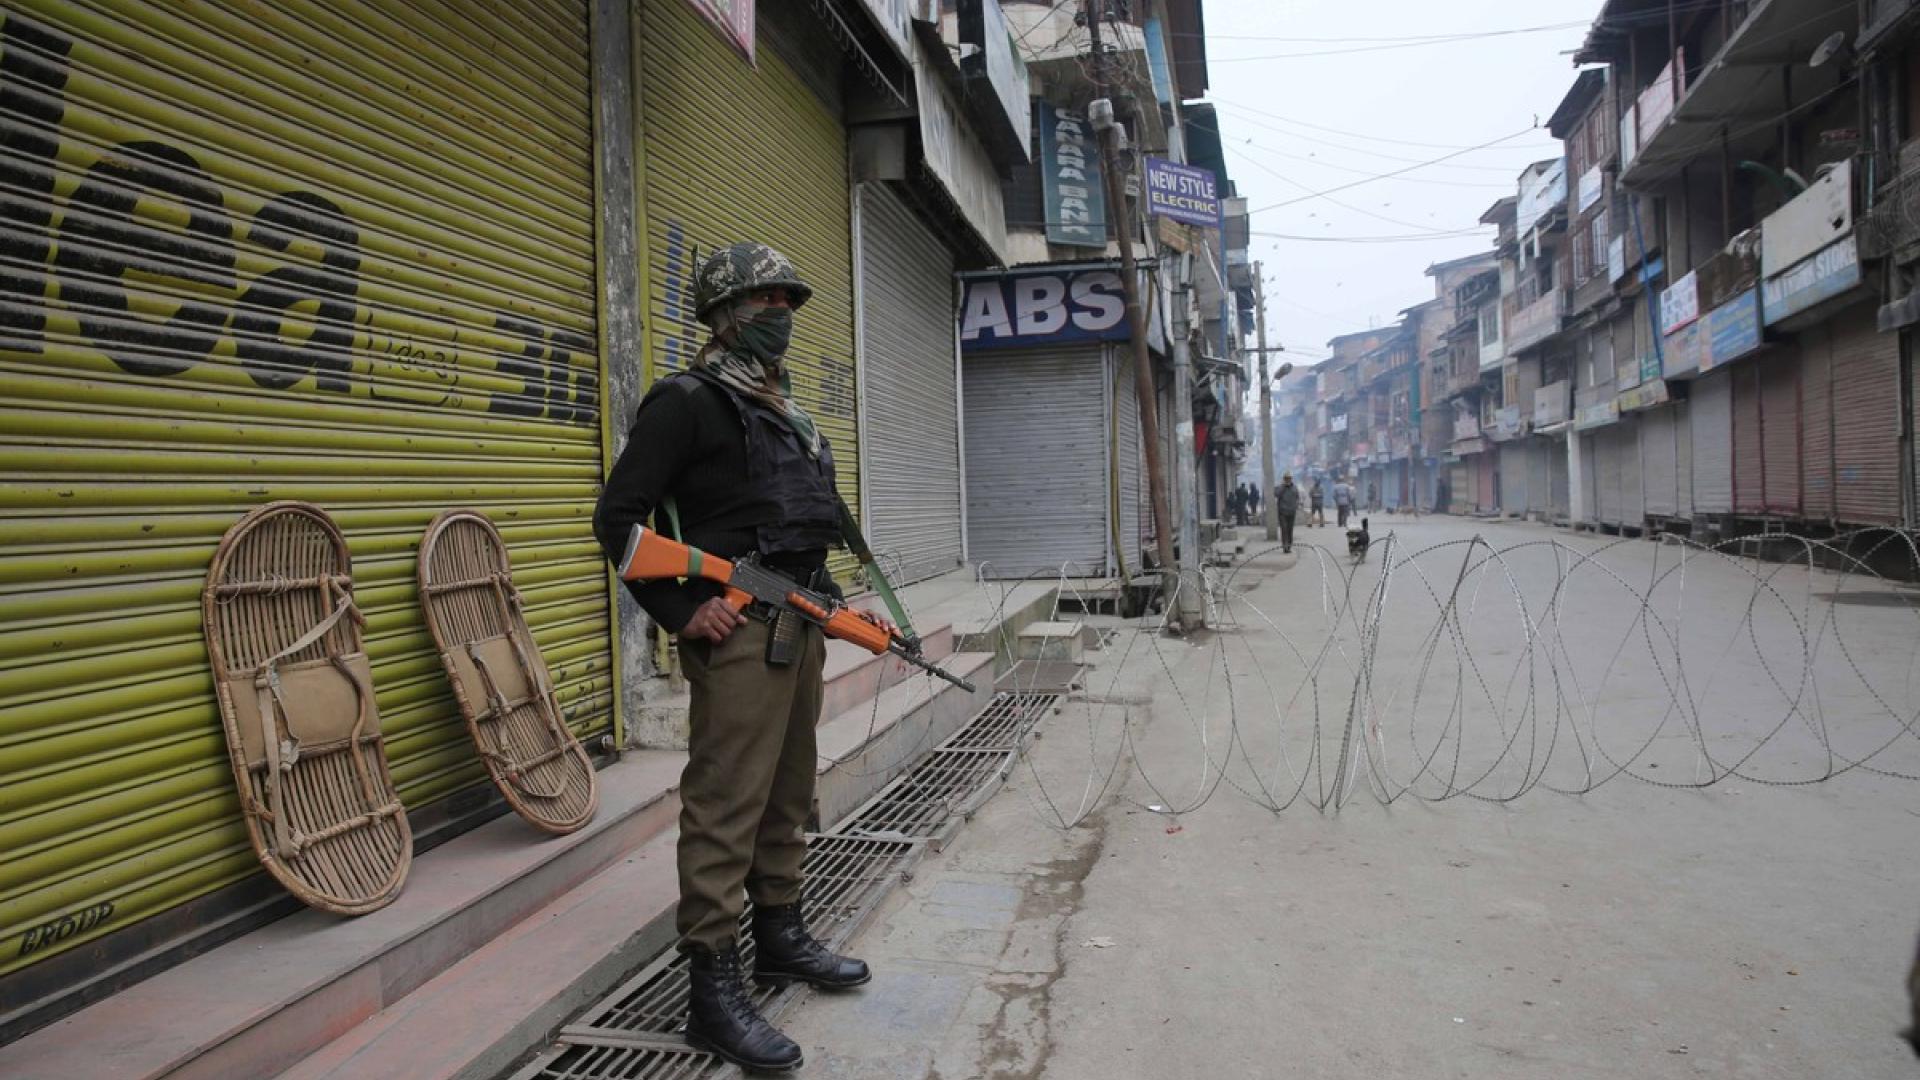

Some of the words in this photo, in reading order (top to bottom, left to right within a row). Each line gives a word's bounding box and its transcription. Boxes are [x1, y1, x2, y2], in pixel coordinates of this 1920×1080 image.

[1055, 107, 1087, 181] CANARA
[1059, 184, 1090, 235] BANK
[1149, 168, 1177, 192] NEW
[1179, 176, 1216, 200] STYLE
[1151, 191, 1217, 215] ELECTRIC
[961, 270, 1126, 340] ABS
